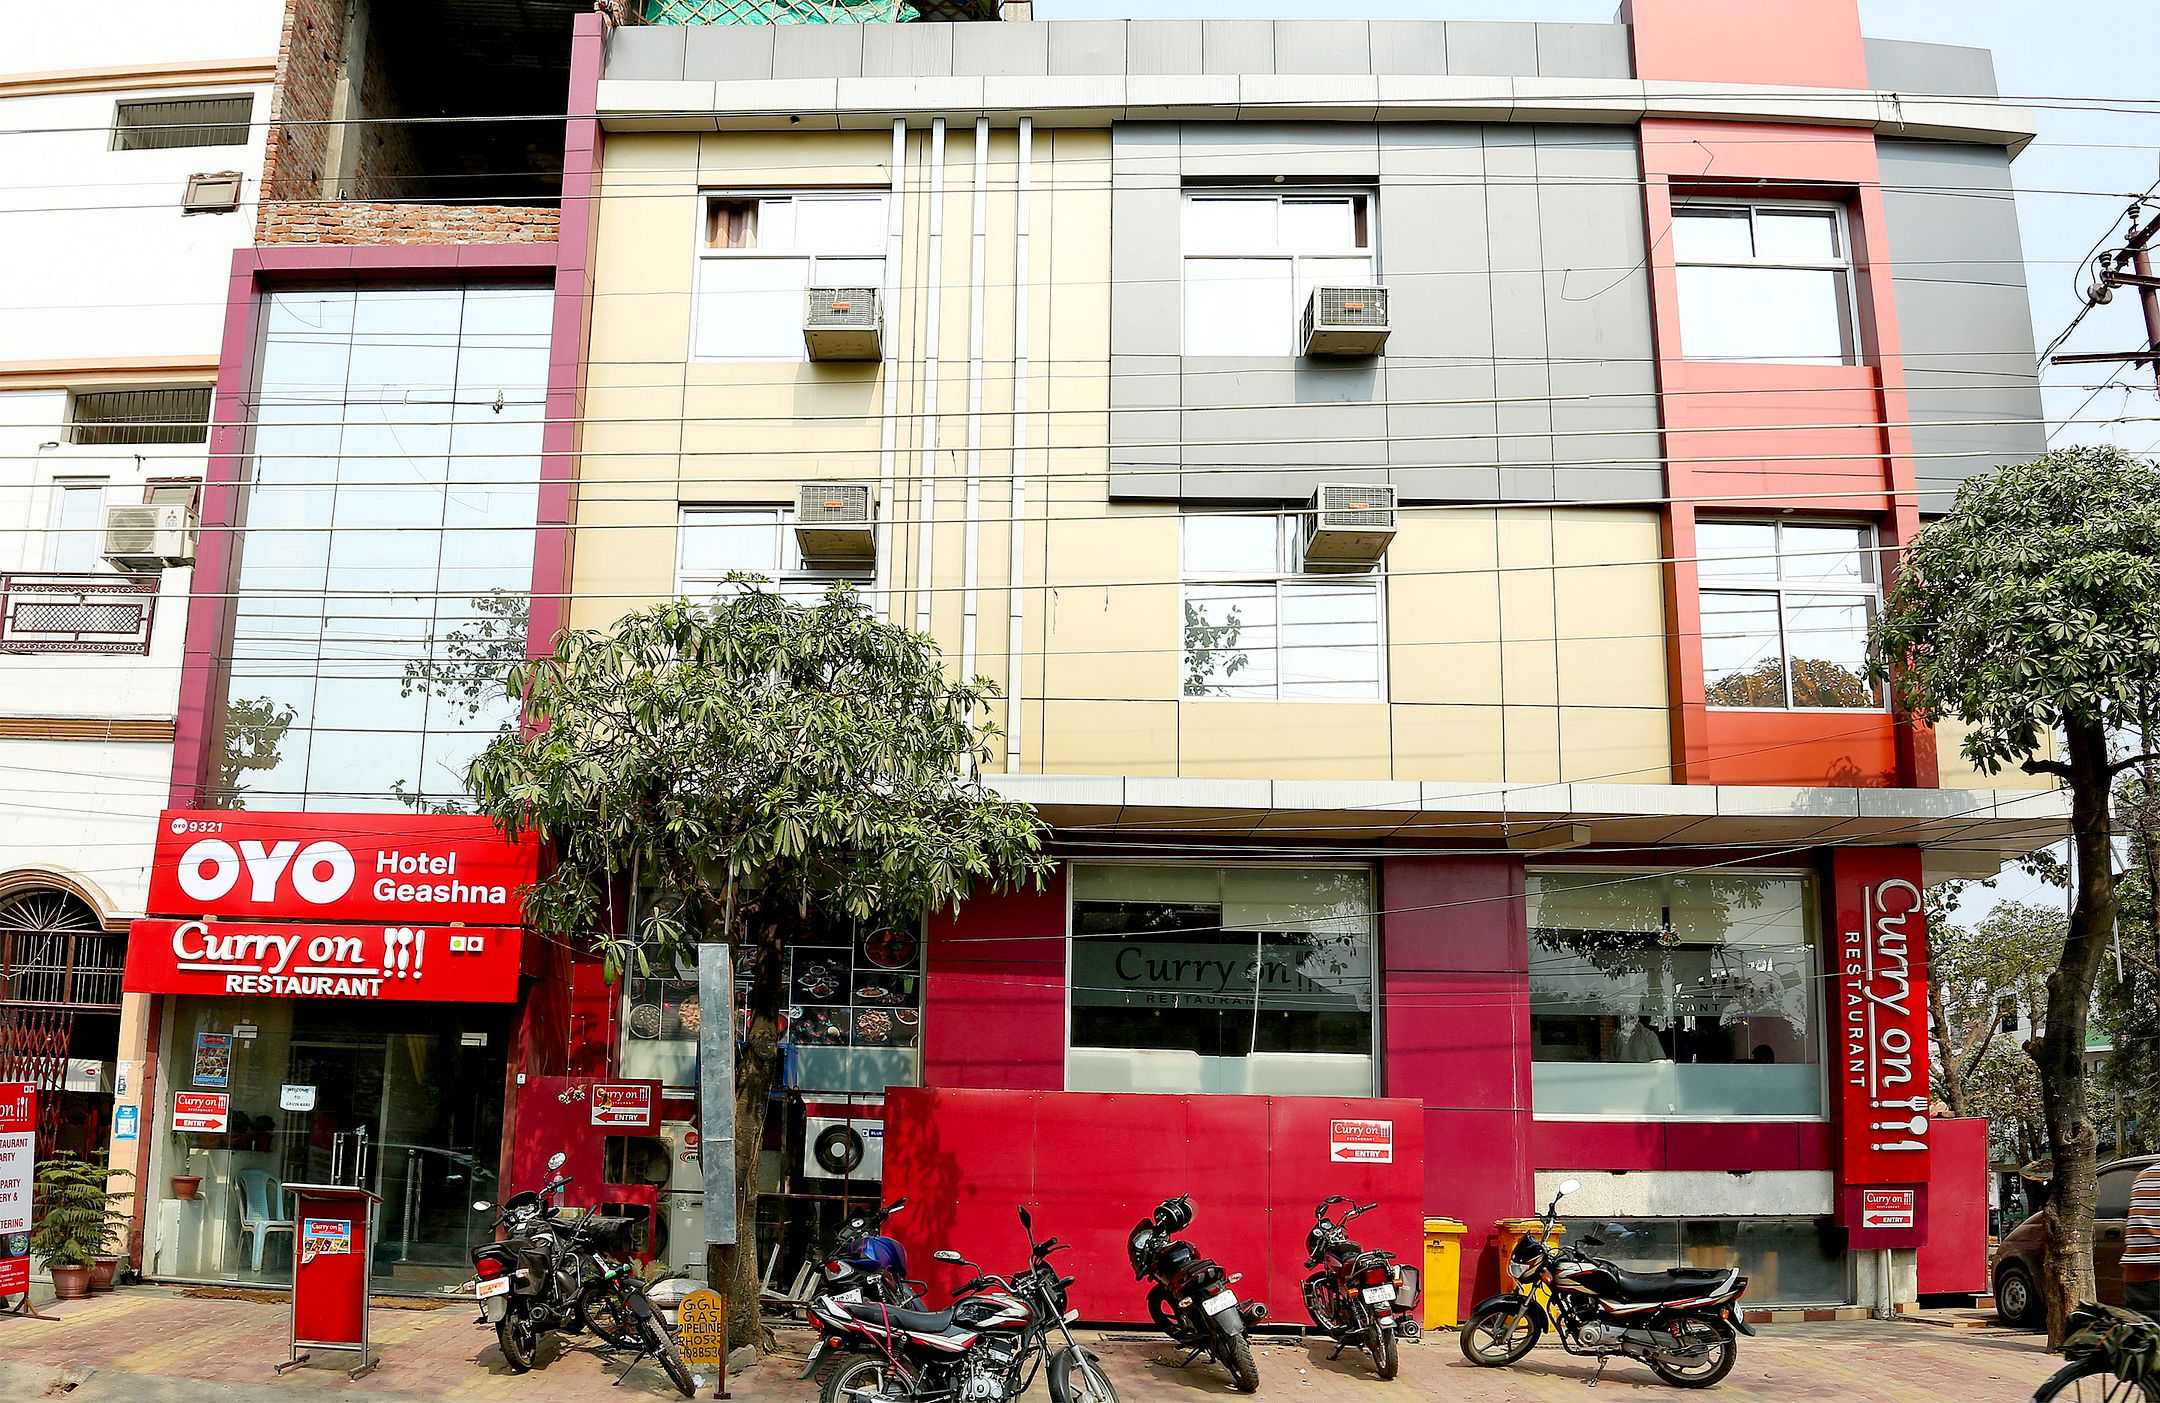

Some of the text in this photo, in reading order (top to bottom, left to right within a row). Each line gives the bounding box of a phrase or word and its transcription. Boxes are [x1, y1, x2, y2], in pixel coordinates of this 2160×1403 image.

[189, 821, 223, 833] 9321
[376, 850, 456, 875] Hotel
[178, 839, 356, 904] OYO
[373, 878, 507, 904] Geashna
[172, 920, 366, 975] Curry on
[1115, 946, 1236, 993] Curry
[225, 974, 384, 997] RESTAURANT
[1863, 878, 1922, 1089] Curry on
[1844, 931, 1866, 1088] RESTAURANT
[178, 1094, 205, 1108] Curry
[625, 1091, 638, 1099] on
[183, 1119, 206, 1128] ENTRY
[1334, 1123, 1378, 1138] Curry on
[0, 1178, 21, 1189] PARTY
[1866, 1192, 1892, 1206] Curry
[683, 1298, 721, 1311] GGL
[683, 1310, 718, 1323] GAS
